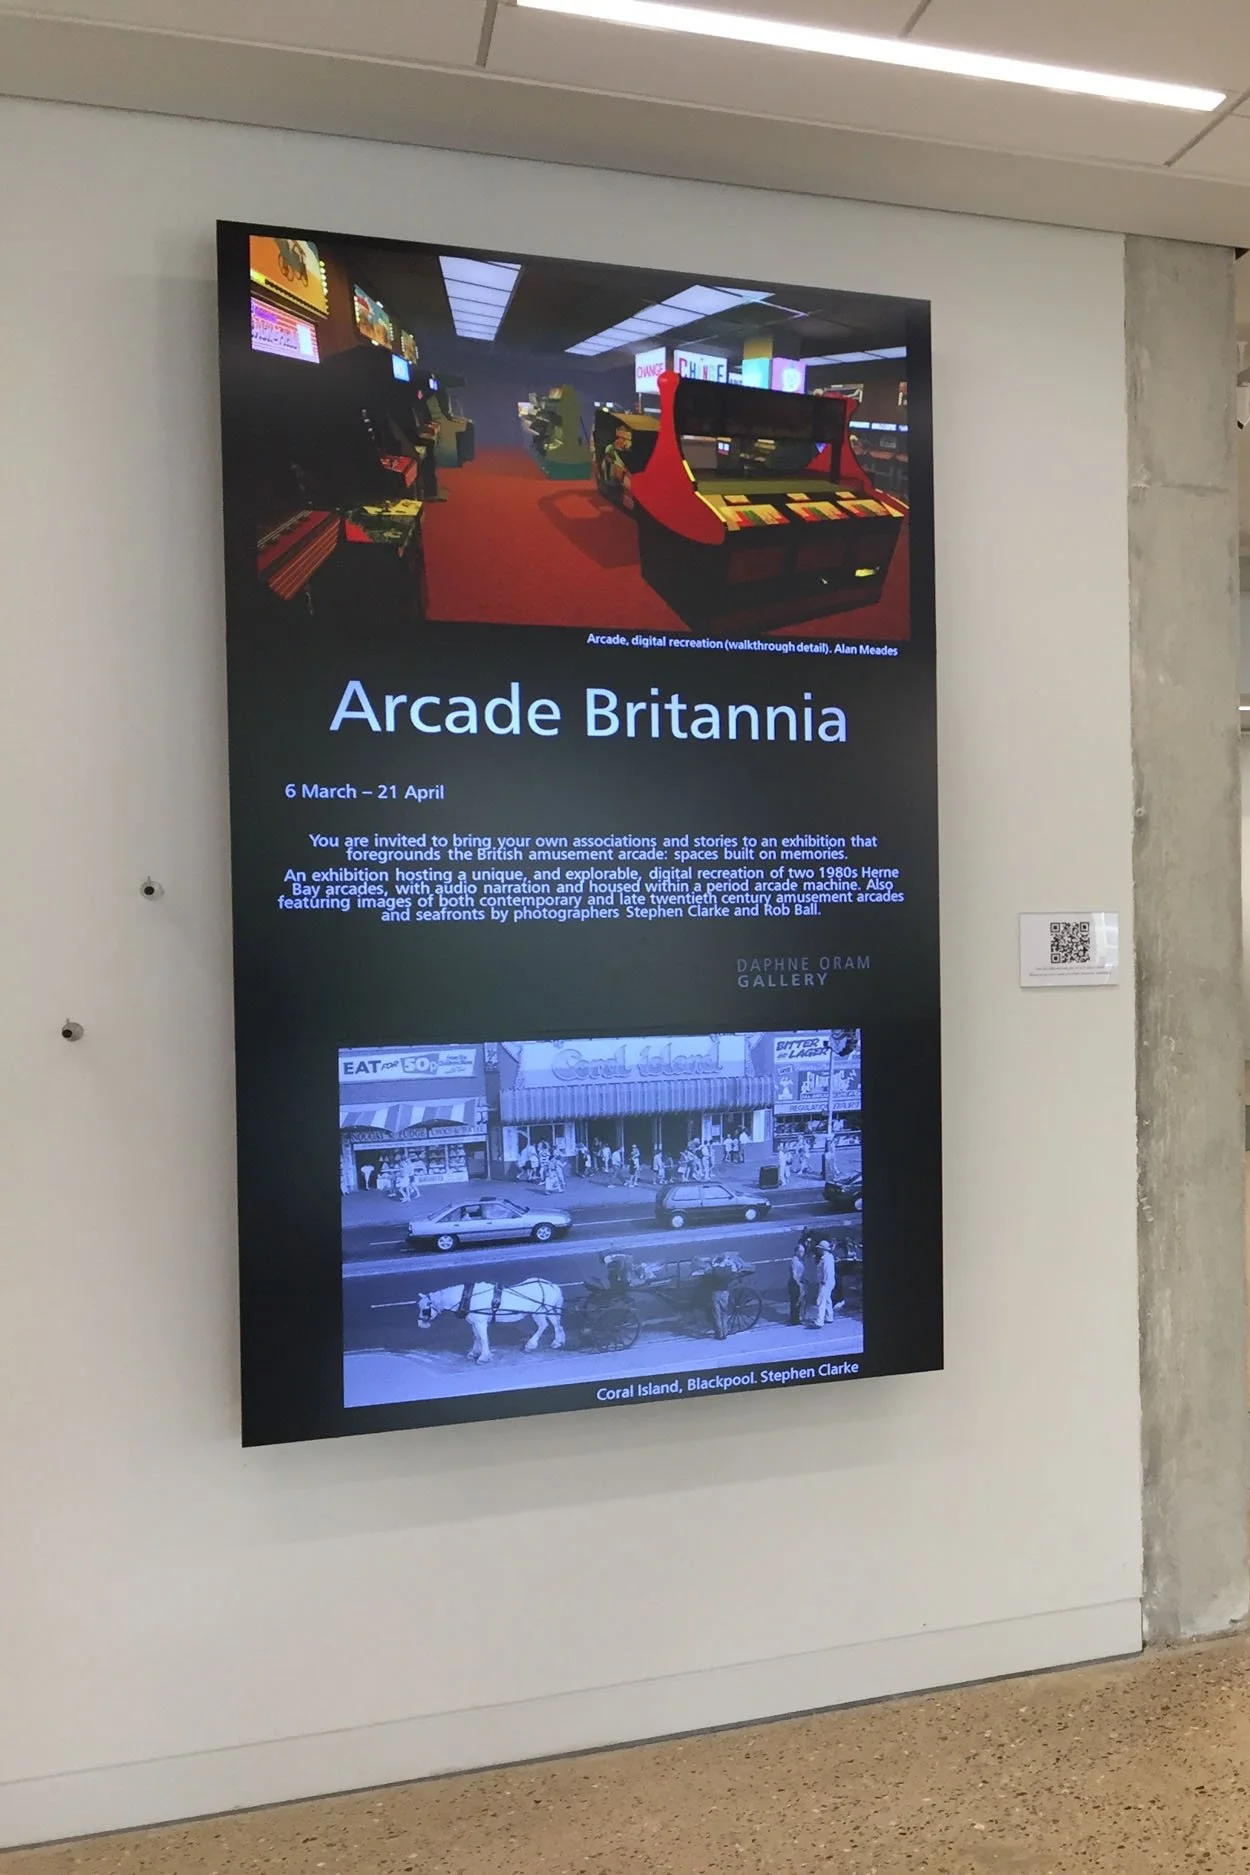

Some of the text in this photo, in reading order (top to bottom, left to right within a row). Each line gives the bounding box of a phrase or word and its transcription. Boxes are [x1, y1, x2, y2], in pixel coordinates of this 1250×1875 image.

[587, 632, 898, 656] Arcade, digital recreation (walkthrough detail). Alan Meades
[329, 680, 848, 743] Arcade Britannia
[285, 783, 297, 799] 6
[302, 783, 357, 799] March
[377, 785, 397, 799] 21
[404, 784, 445, 803] April
[309, 833, 878, 851] You are invited to bring your own associations and stories to an exhibition that
[346, 847, 848, 864] foregrounds the British amusement arcade: spaces built on memories.
[284, 867, 900, 885] An exhibition hosting a unique, and explorable, digital recreation of two 1980s Herne
[292, 879, 894, 898] Bay arcades, with audio narration and housed within a period arcade machine. Also
[278, 890, 905, 912] featuring images of both contemporary and late twentieth century amusement arcades
[381, 903, 821, 923] and seafronts by photographers Stephen Clarke and Rob Ball.
[737, 955, 871, 973] DAPHNE ORAM
[737, 973, 829, 988] GALLERY
[776, 1038, 820, 1051] BITTER
[788, 1047, 829, 1059] LAGER
[343, 1060, 381, 1075] EAT
[403, 1056, 437, 1073] 50p
[597, 1362, 860, 1401] Coral Island, Blackpool. Stephen Clarke
